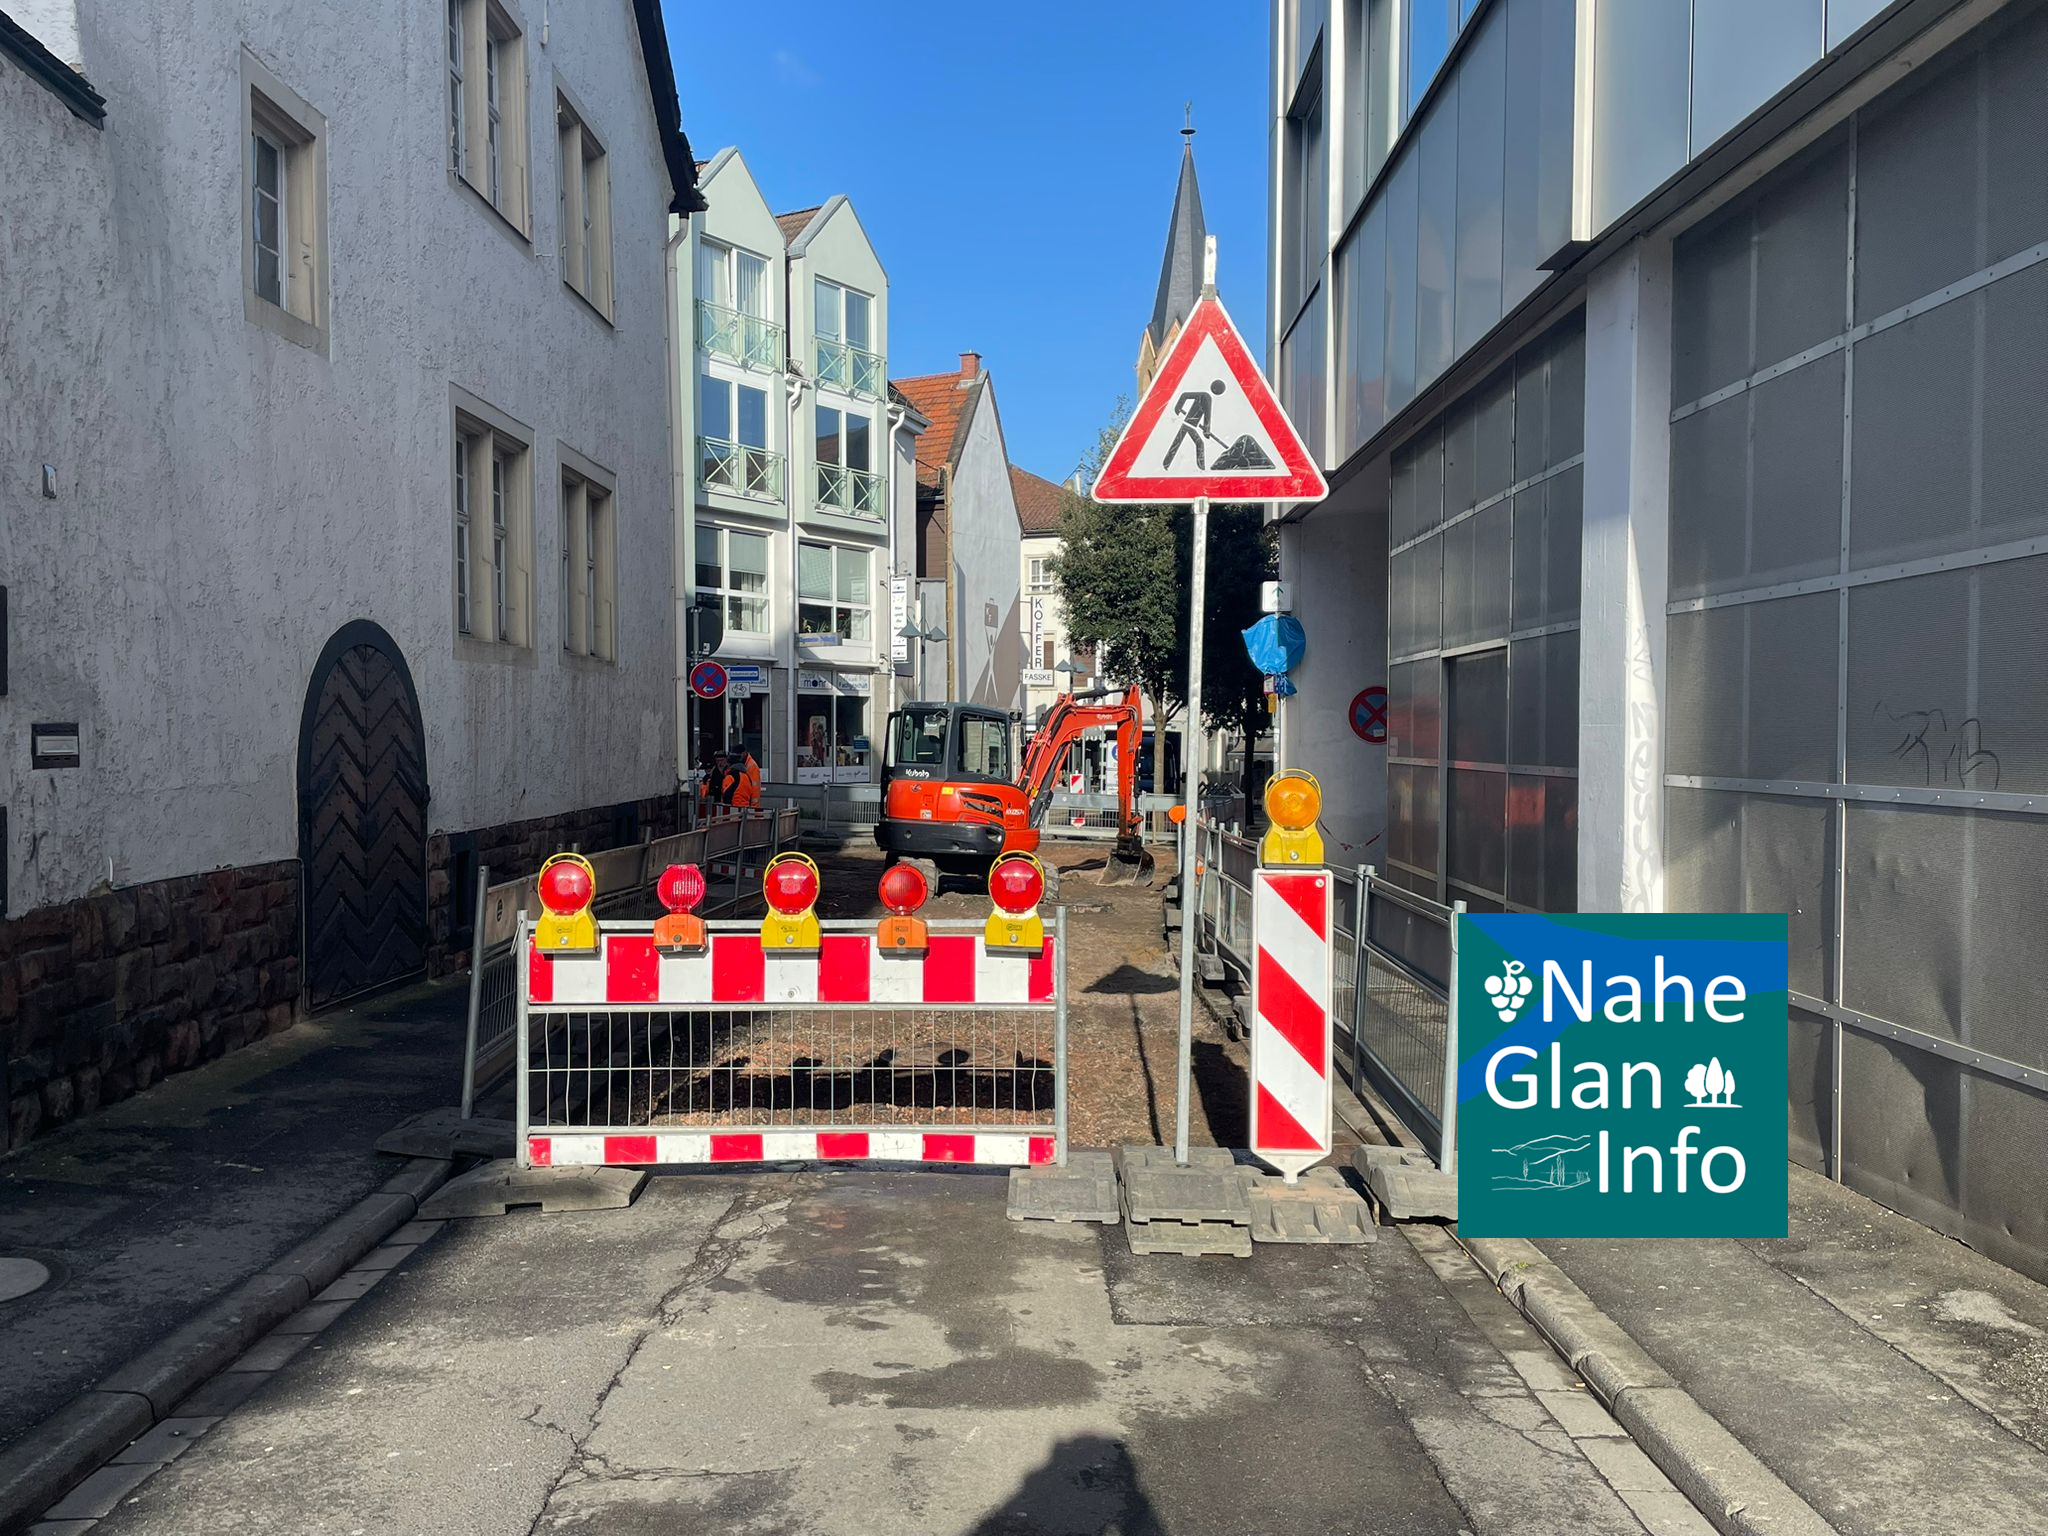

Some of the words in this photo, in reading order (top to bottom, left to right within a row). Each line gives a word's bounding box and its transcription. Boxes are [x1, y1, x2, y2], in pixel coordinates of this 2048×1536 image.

[1034, 598, 1043, 668] KOFFER
[1024, 673, 1052, 681] FASSKE
[905, 768, 930, 779] Kubota
